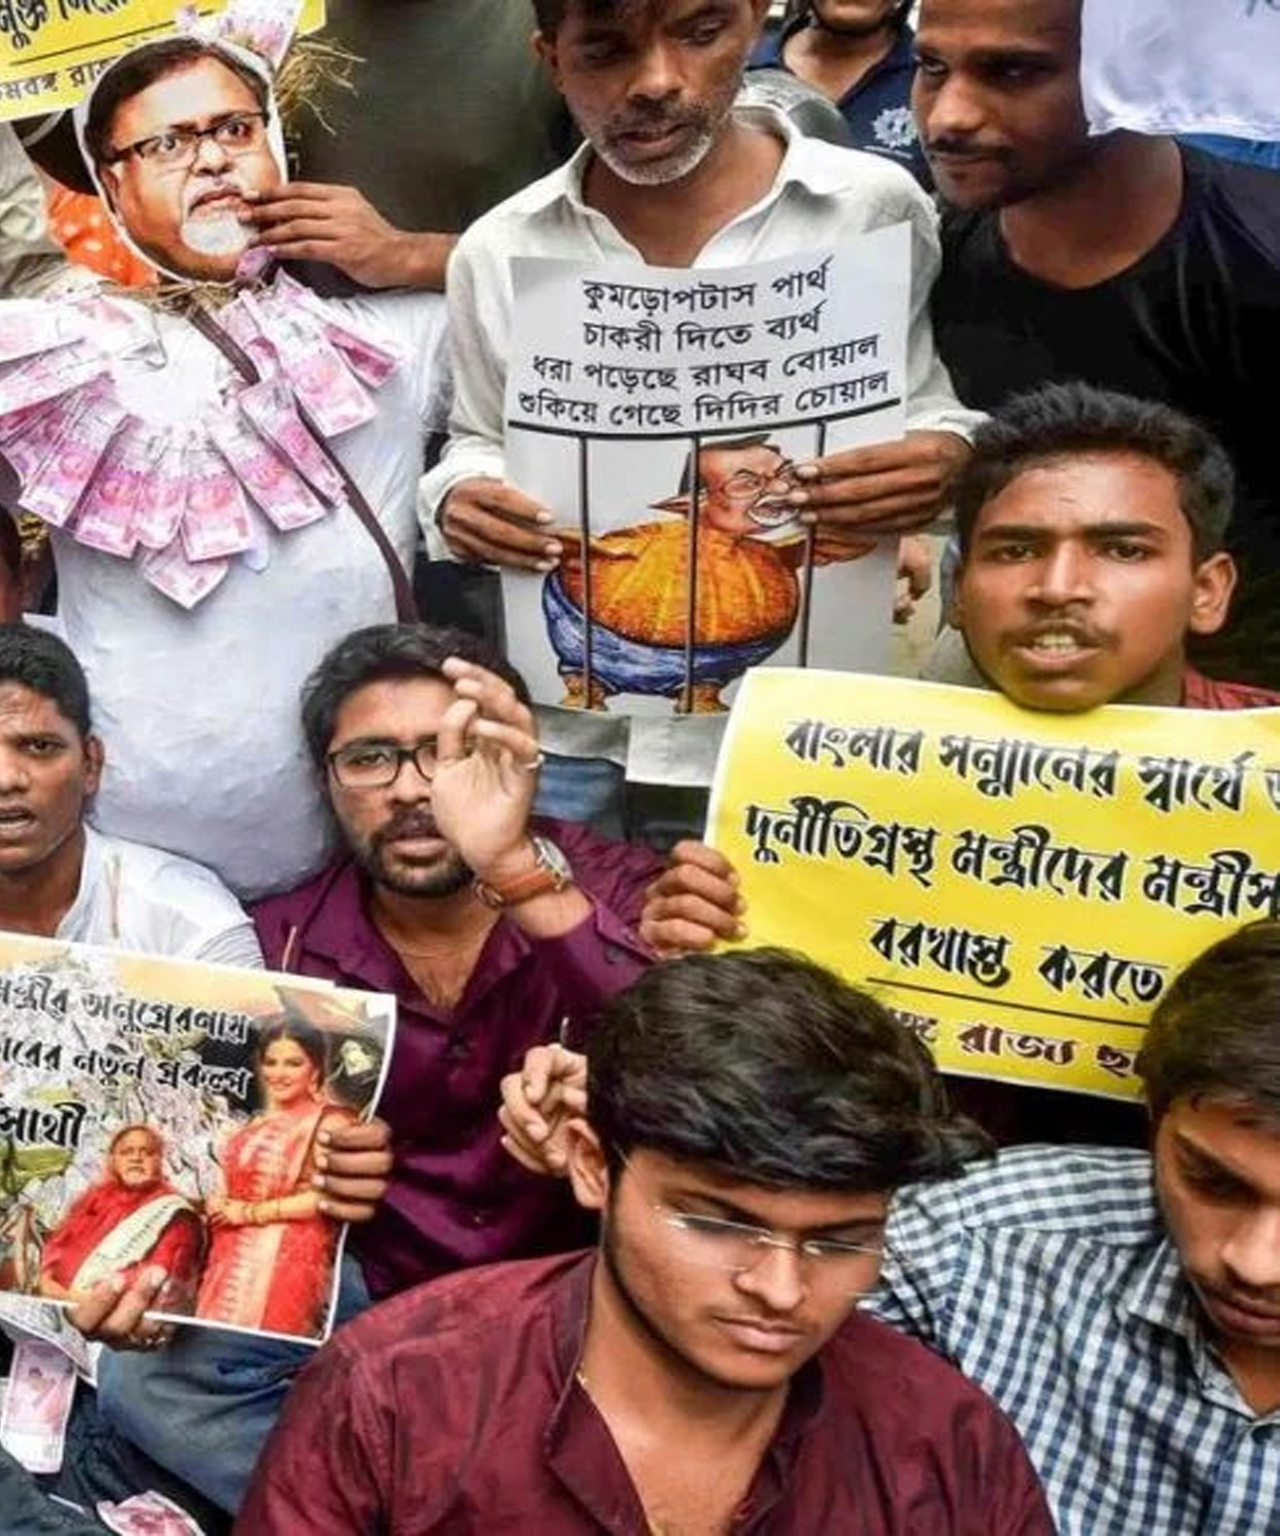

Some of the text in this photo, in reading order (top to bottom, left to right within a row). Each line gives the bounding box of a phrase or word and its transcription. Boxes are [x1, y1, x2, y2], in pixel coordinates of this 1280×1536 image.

[582, 255, 834, 317] কুমড়োপটাস পার্থ
[582, 299, 827, 352] চাকরী দিতে ব্যর্থ
[532, 334, 880, 394] ধরা পড়েছে রাঘব বোয়াল
[518, 371, 888, 428] শুকিয়ে গেছে দিদির চোয়াল
[786, 719, 925, 775] বাংলার
[1137, 750, 1256, 812] স্বার্থে
[952, 824, 1129, 902] মন্ত্রীদের
[1144, 850, 1280, 918] মন্ত্রীস
[868, 916, 1169, 1004] বরখাস্ত করতে
[73, 1043, 145, 1087] নতুন
[156, 1057, 250, 1098] প্রকল্প
[957, 1021, 1078, 1065] রাজ্য
